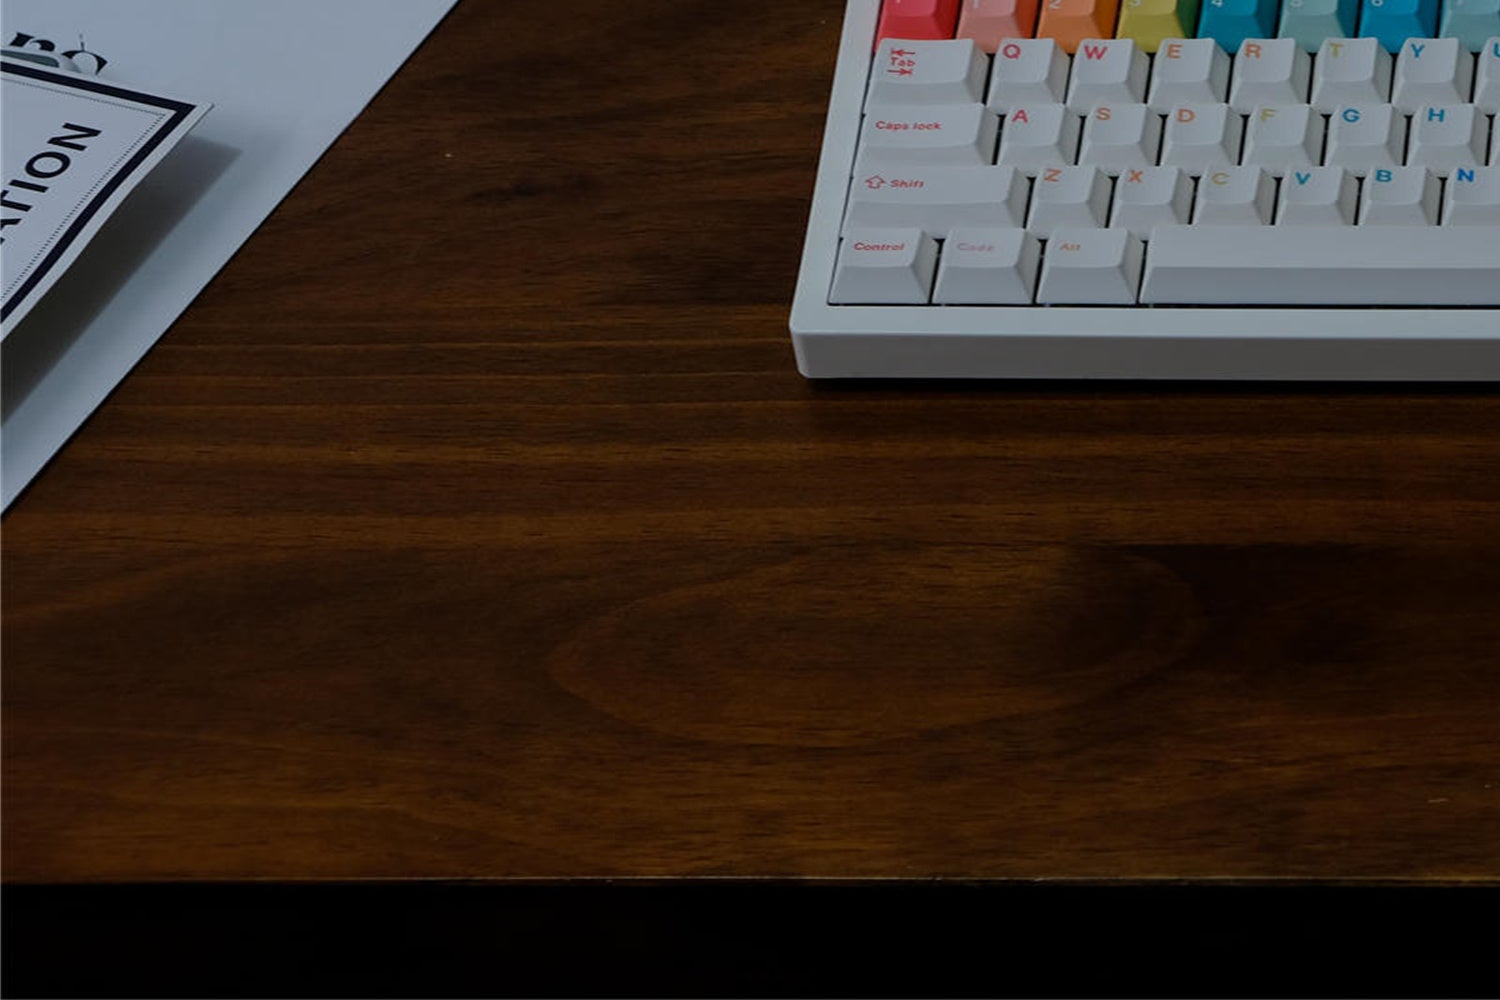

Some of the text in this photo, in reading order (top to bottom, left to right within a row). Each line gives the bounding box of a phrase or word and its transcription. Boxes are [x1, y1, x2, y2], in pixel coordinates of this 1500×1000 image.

[1003, 44, 1021, 59] Q
[1084, 46, 1107, 59] W
[1167, 44, 1182, 58] E
[1245, 44, 1261, 57] R
[1330, 43, 1343, 57] T
[1411, 44, 1425, 58] Y
[1013, 109, 1029, 123] A
[1097, 108, 1111, 120] S
[1177, 109, 1195, 122] D
[1261, 109, 1275, 121] F
[1343, 109, 1360, 122] G
[1428, 108, 1445, 122] H
[876, 121, 941, 131] Caps lock
[1044, 169, 1061, 182] Z
[1129, 170, 1142, 182] X
[1213, 173, 1228, 185] C
[1297, 173, 1310, 185] V
[1376, 170, 1391, 181] B
[1457, 169, 1474, 182] N
[0, 122, 102, 246] TION
[891, 179, 924, 188] Shift
[854, 243, 904, 251] Control
